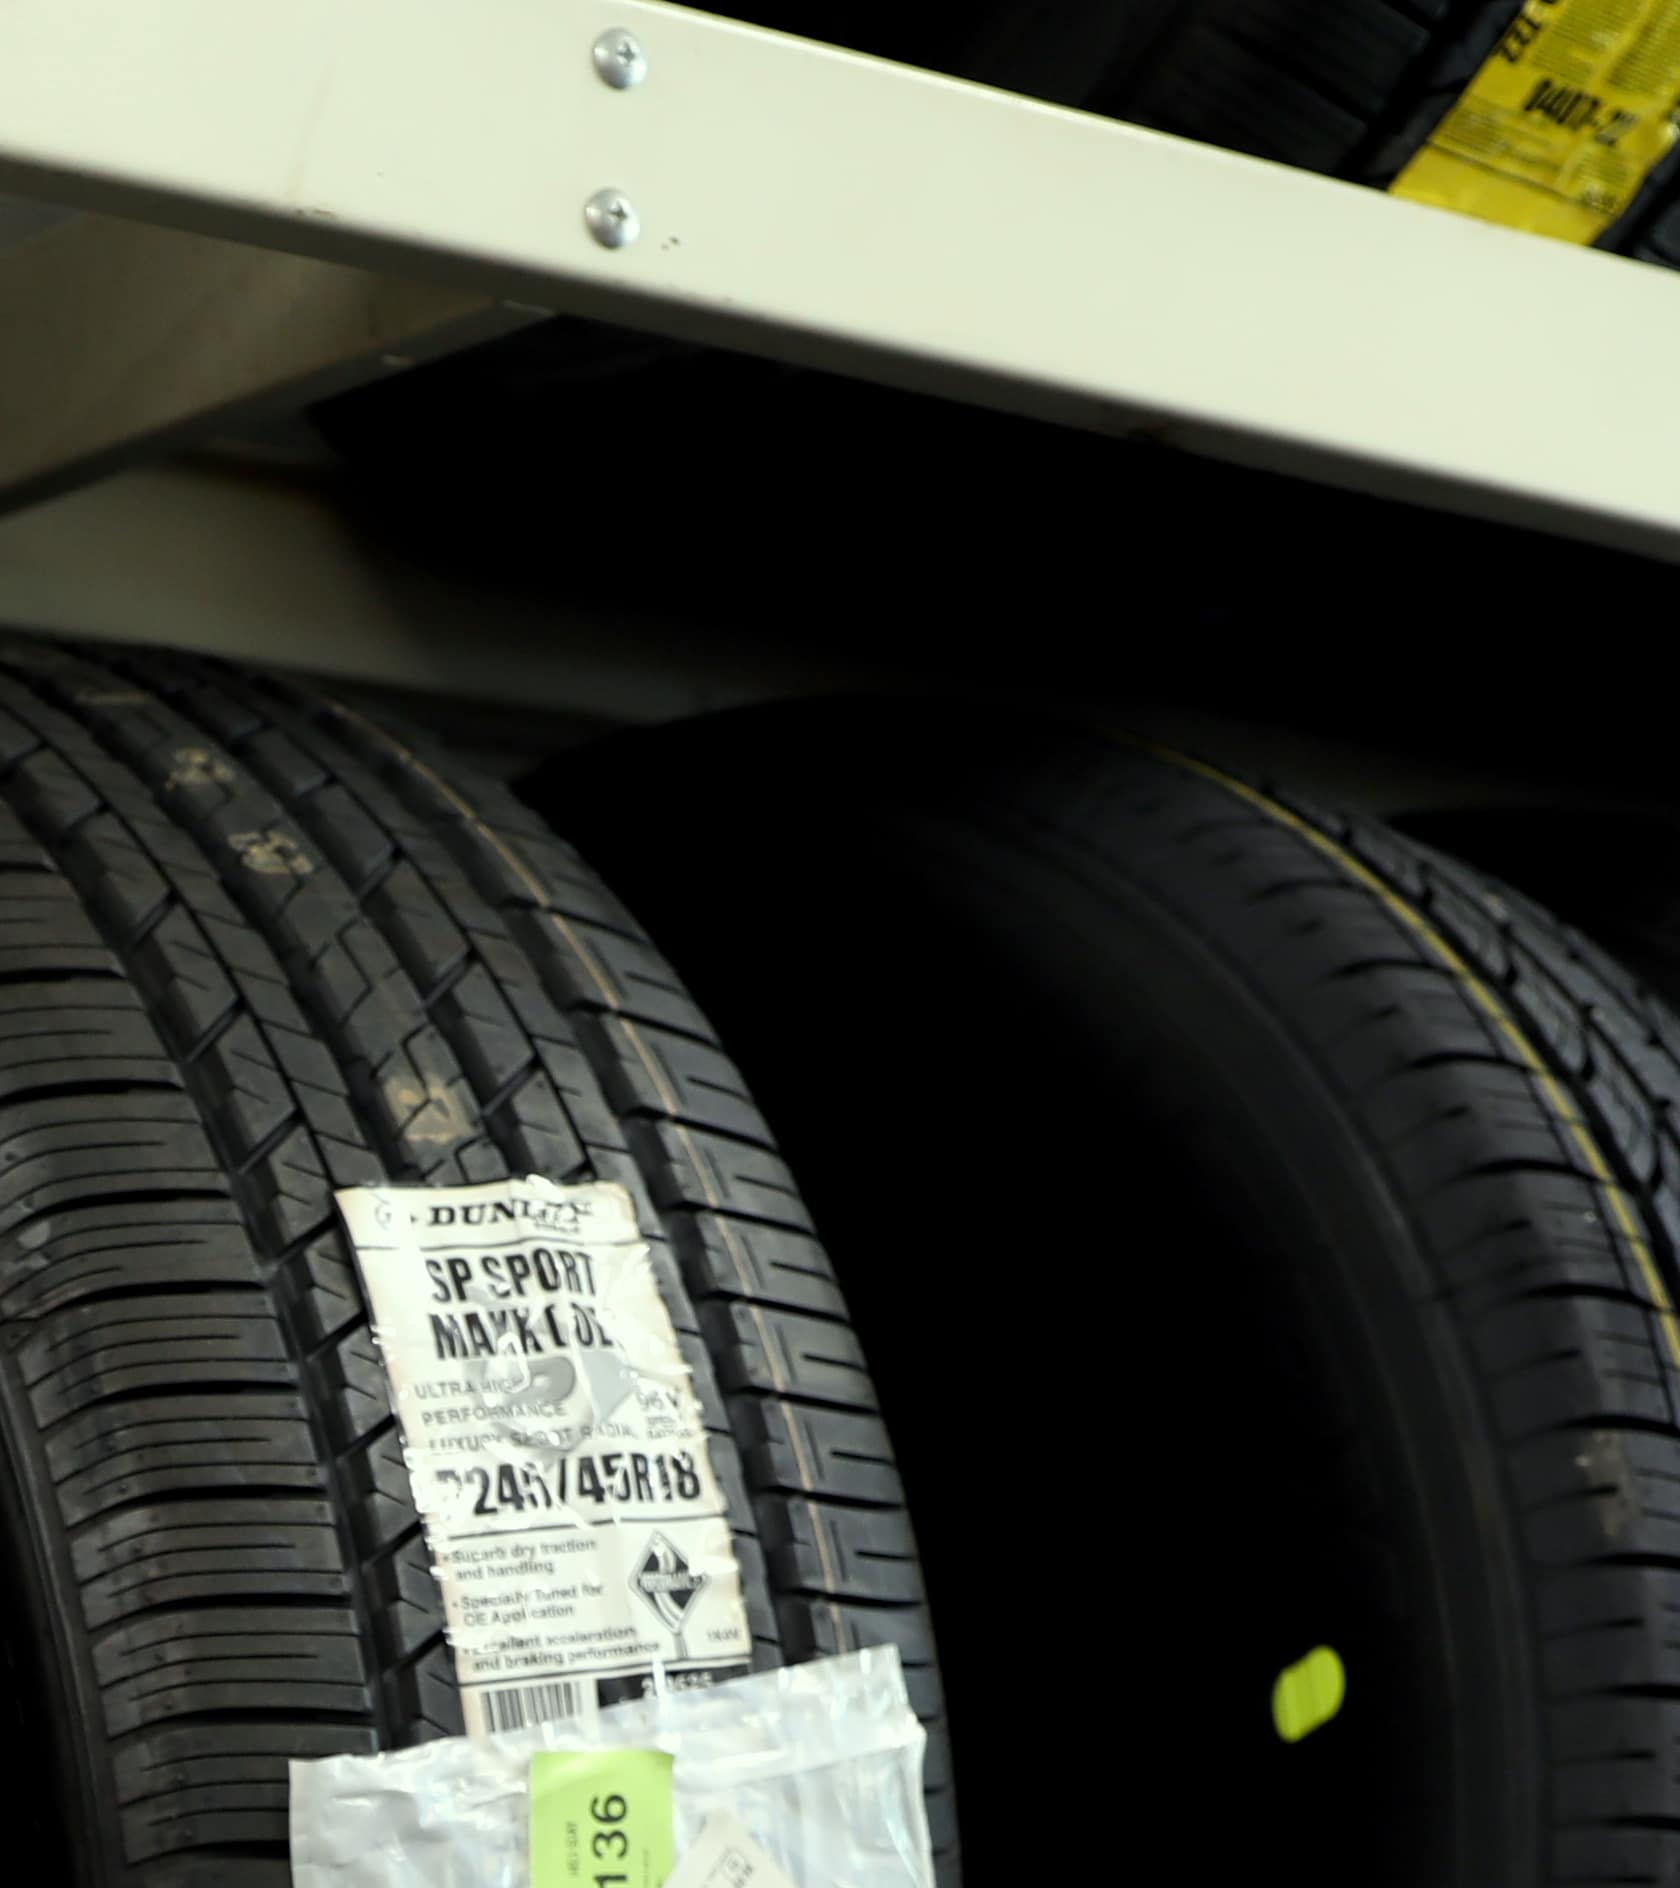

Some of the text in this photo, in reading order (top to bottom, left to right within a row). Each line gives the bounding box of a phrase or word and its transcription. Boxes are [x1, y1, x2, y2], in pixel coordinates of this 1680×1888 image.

[425, 1247, 598, 1303] SP SPORT
[427, 1308, 545, 1360] MAXX
[413, 1380, 476, 1400] ULTRA
[421, 1402, 569, 1427] PERFORMANCE
[509, 1538, 598, 1560] dry traction
[455, 1558, 555, 1580] and handling
[462, 1613, 489, 1626] OE
[472, 1640, 661, 1673] and braking performance
